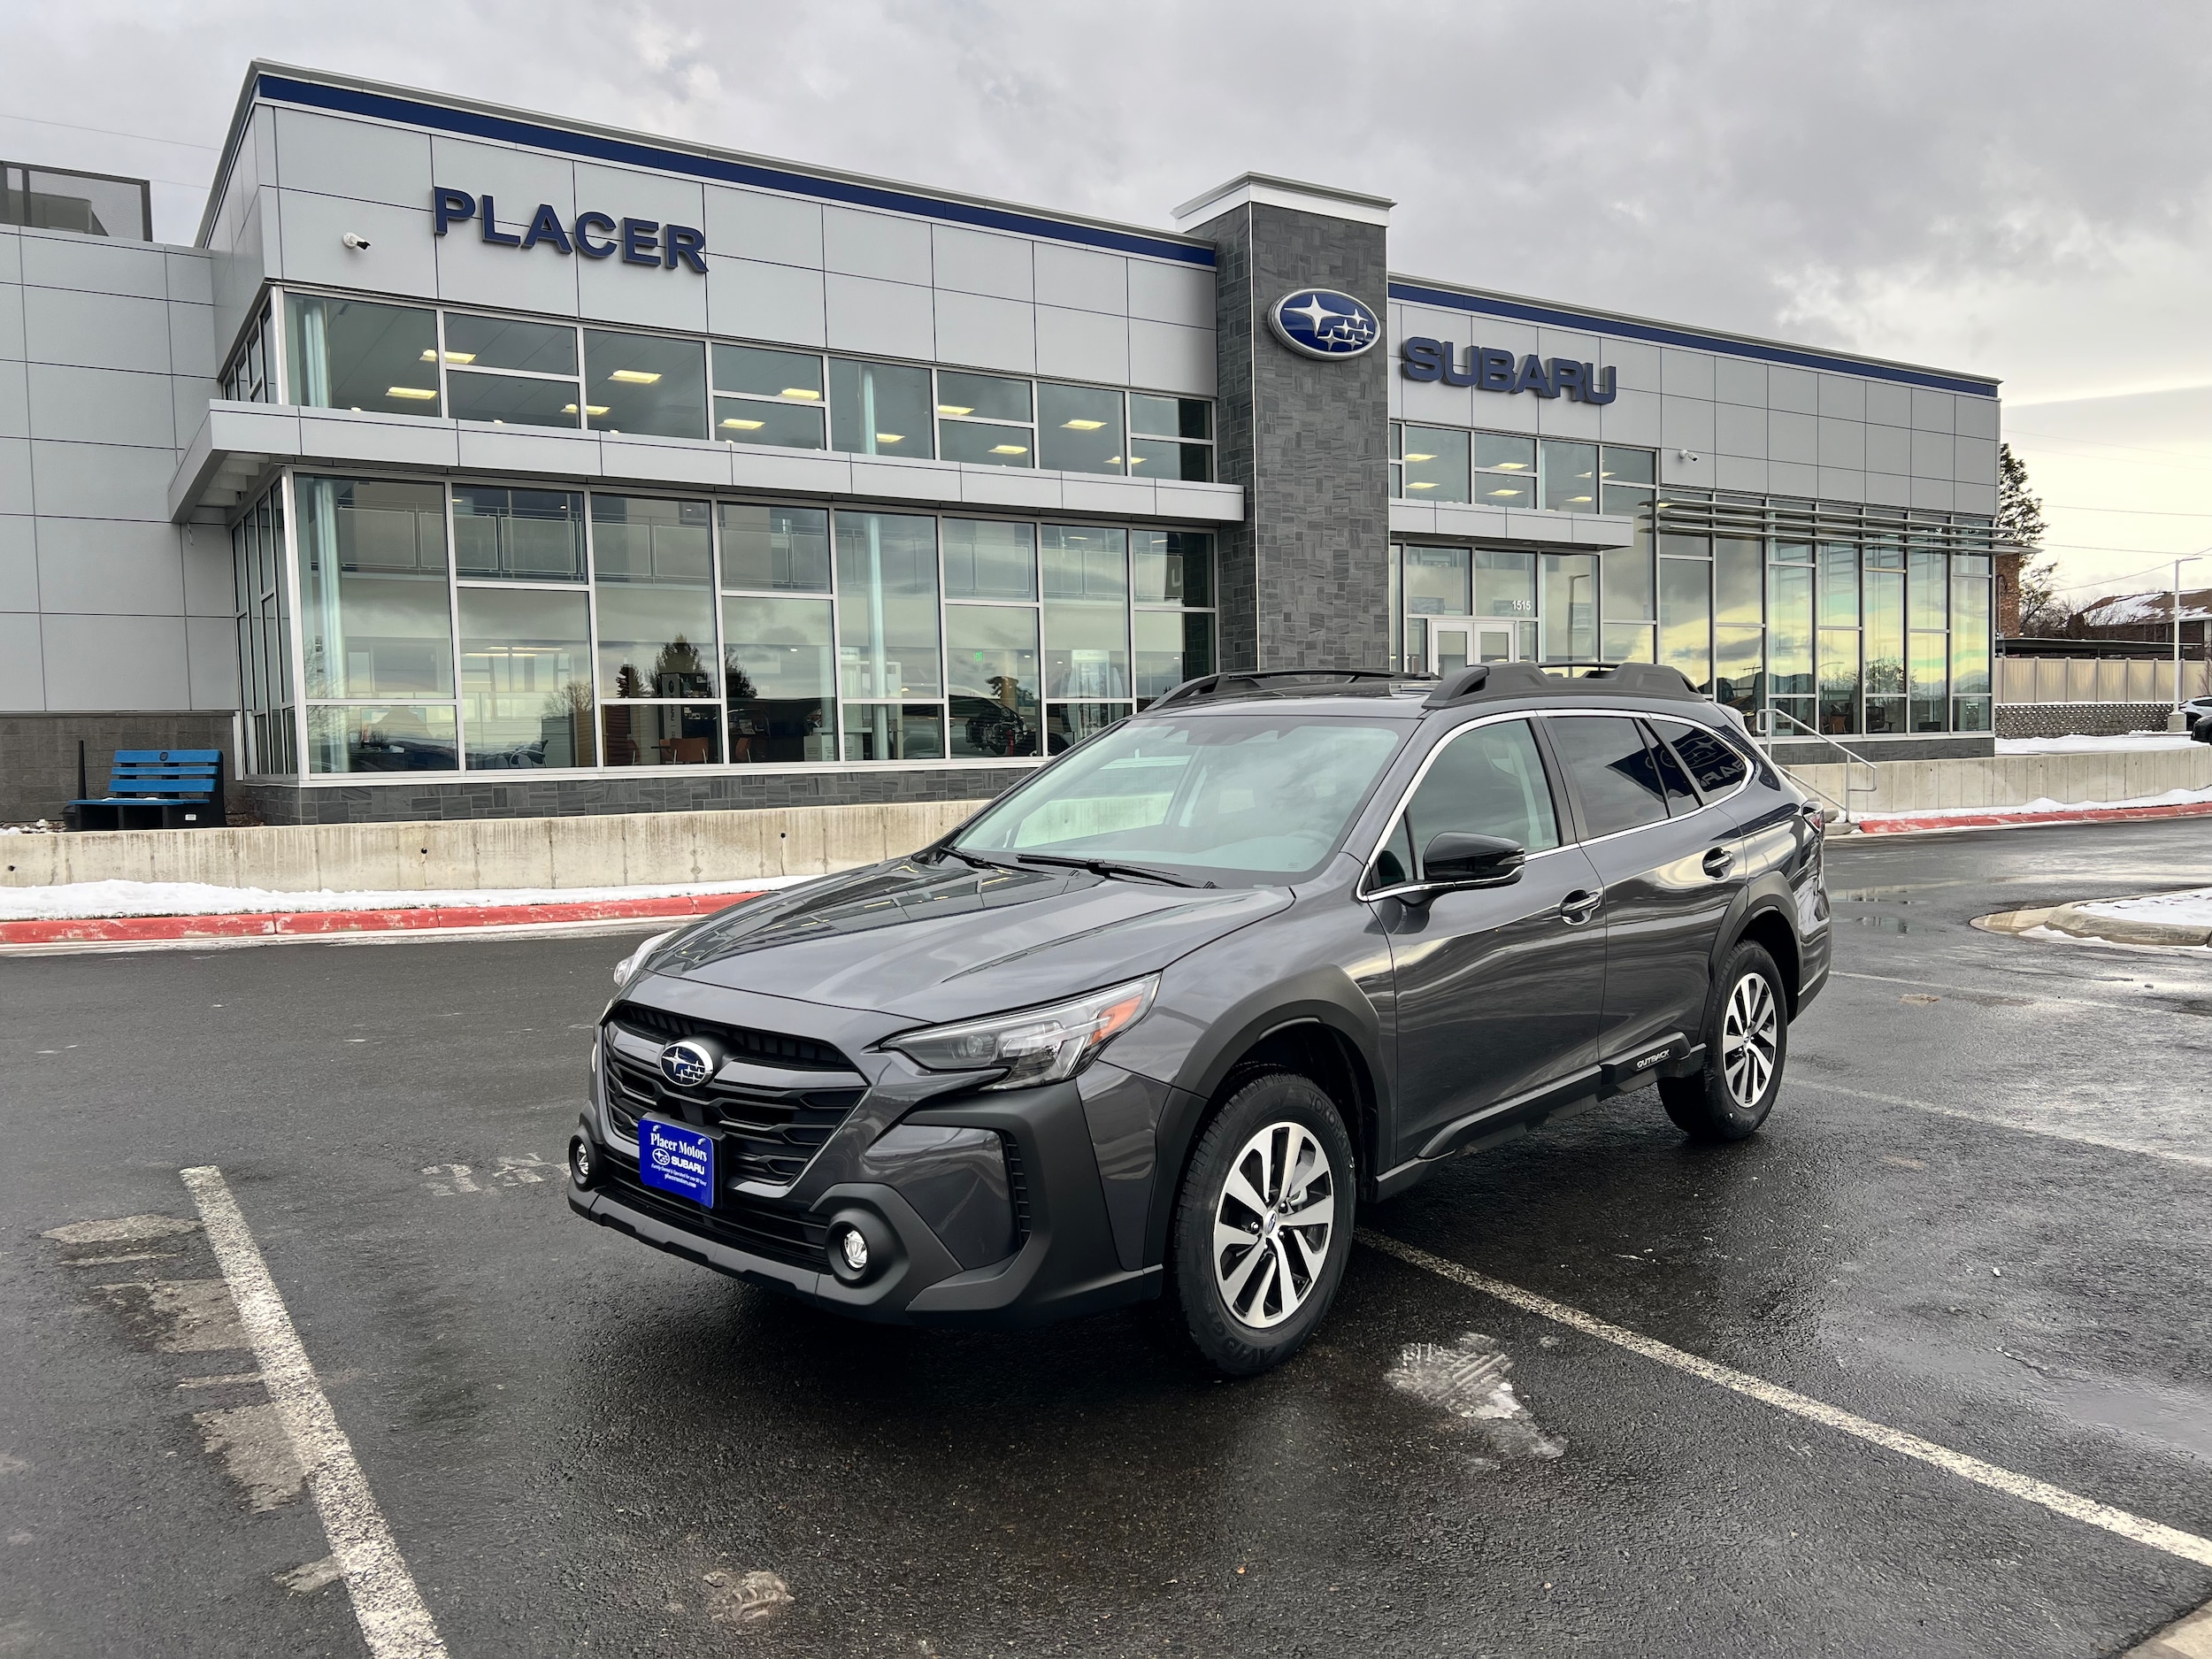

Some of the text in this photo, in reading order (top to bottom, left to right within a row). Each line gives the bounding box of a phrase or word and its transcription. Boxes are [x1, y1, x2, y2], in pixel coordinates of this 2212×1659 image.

[433, 186, 709, 273] PLACER
[1402, 336, 1617, 405] SUBARU
[1512, 600, 1531, 611] 1515
[1636, 1048, 1671, 1068] OUTBACK
[650, 1133, 707, 1163] Placer Motors
[671, 1156, 705, 1175] SUBARU
